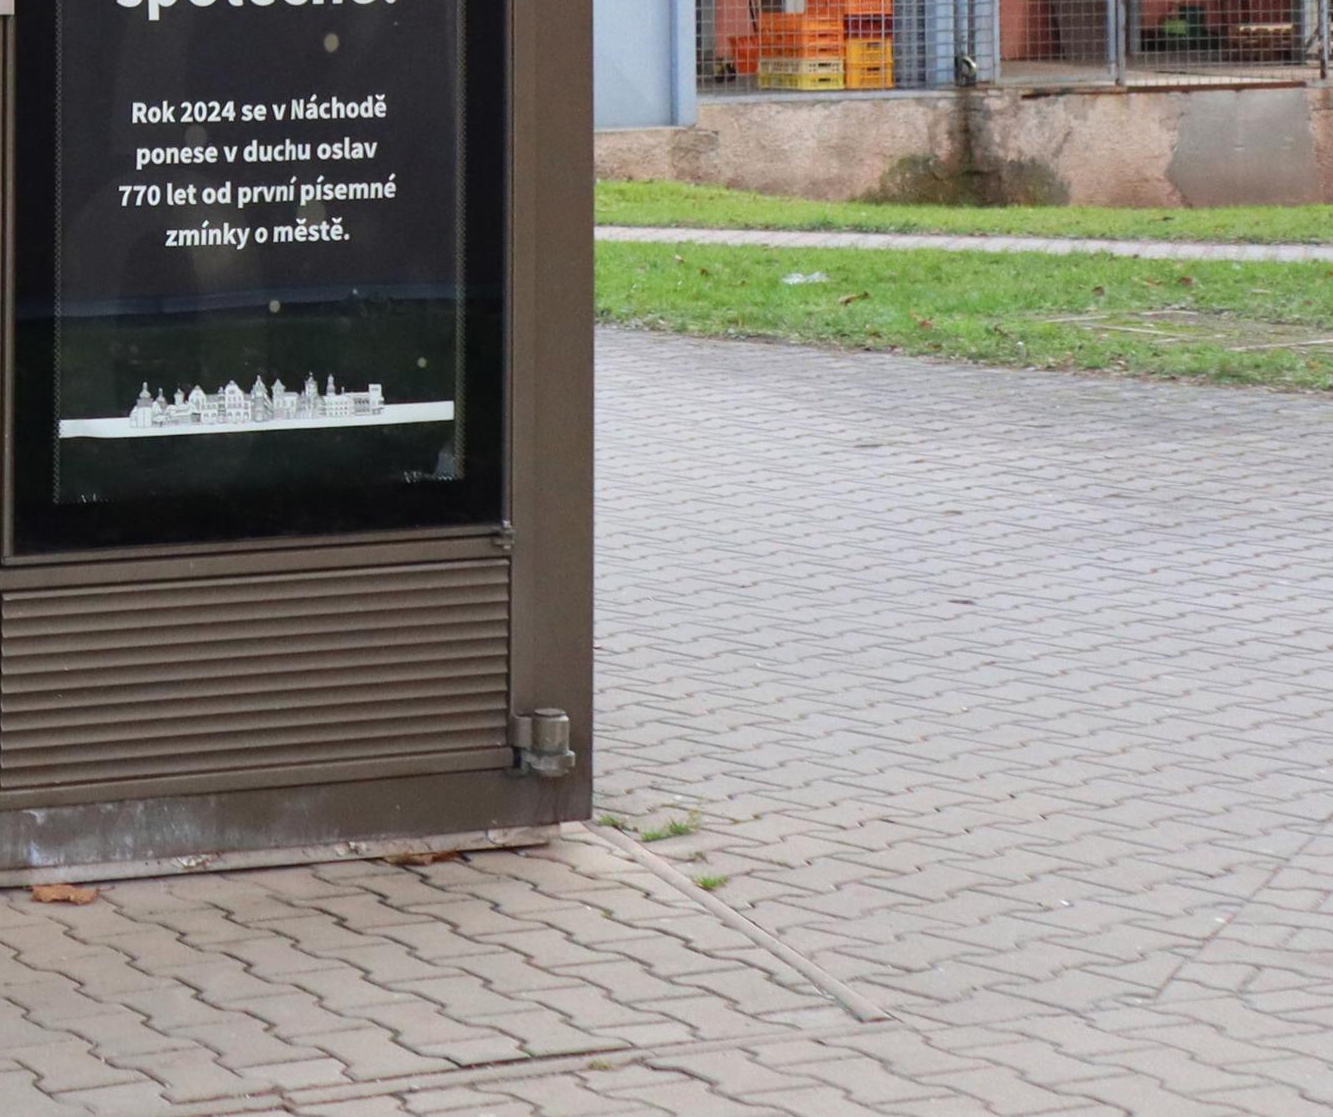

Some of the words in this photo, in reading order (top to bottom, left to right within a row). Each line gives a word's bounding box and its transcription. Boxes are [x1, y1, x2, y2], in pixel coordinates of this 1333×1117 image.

[132, 101, 175, 123] Rok
[181, 101, 235, 122] 2024
[242, 105, 266, 121] se
[272, 104, 286, 120] v
[291, 94, 386, 119] Náchodě
[137, 147, 218, 170] ponese
[224, 146, 237, 162] v
[244, 139, 310, 162] duchu
[317, 137, 377, 159] oslav
[119, 185, 160, 206] 770
[167, 183, 196, 205] let
[202, 182, 231, 204] od
[238, 176, 296, 208] první
[300, 173, 396, 206] písemné
[165, 220, 250, 249] zmínky
[255, 227, 268, 243] o
[273, 217, 349, 242] městě.
